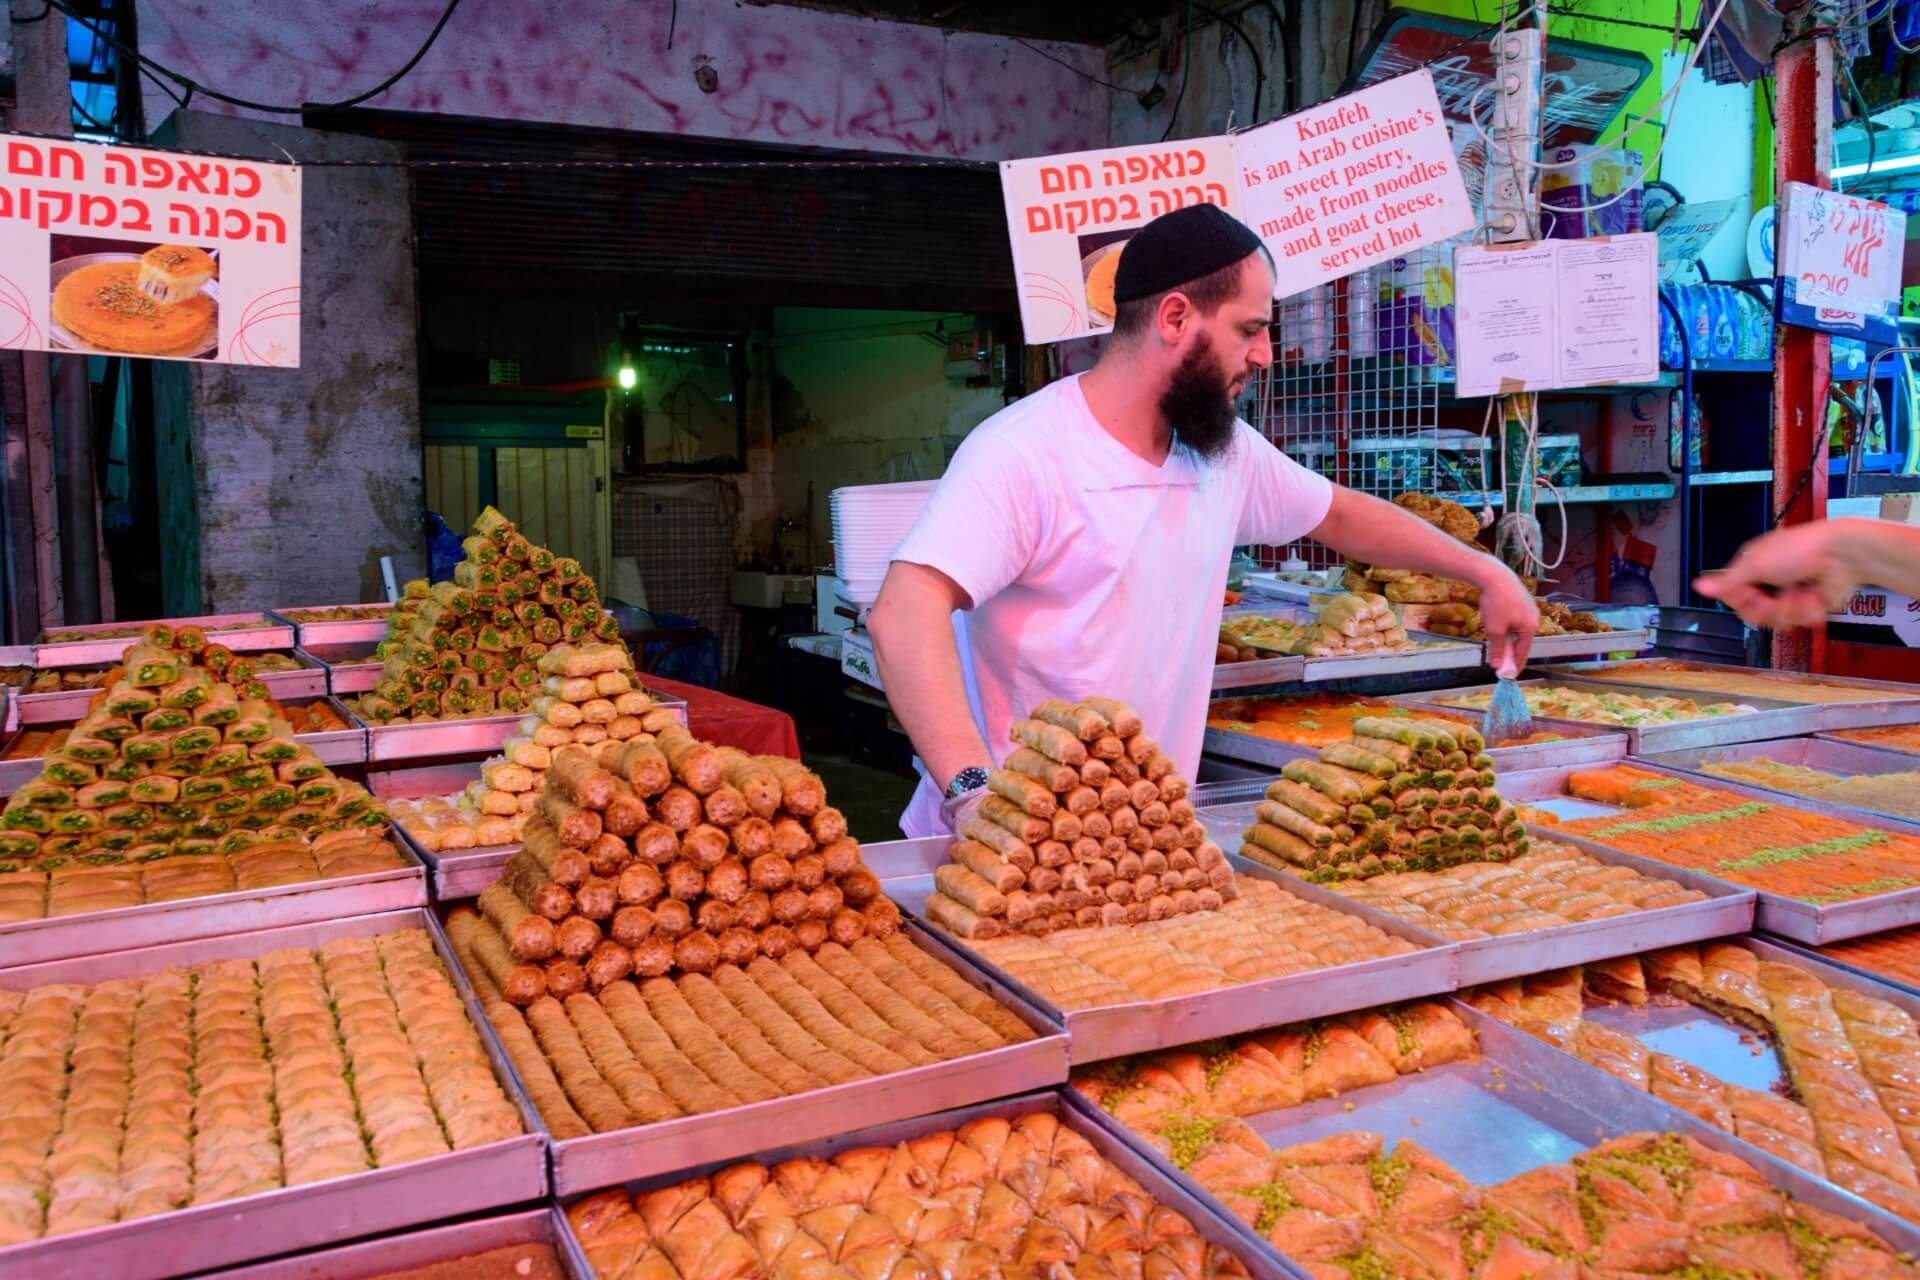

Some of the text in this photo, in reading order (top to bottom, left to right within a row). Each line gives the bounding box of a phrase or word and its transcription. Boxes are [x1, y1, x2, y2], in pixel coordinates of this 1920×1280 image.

[1296, 102, 1370, 142] Knafeh
[7, 141, 262, 199] כנאפה חם
[1244, 108, 1435, 187] is an Arab cuisine's
[1040, 149, 1206, 195] כנאפה חם
[1284, 147, 1413, 201] sweet pastry,
[1026, 193, 1141, 235] במקום
[1259, 158, 1447, 238] made from noodles
[168, 202, 287, 244] הכנה
[1284, 191, 1443, 257] and goat cheese,
[1321, 234, 1386, 271] served
[1387, 223, 1422, 249] hot
[1844, 235, 1883, 278] ללא
[1801, 271, 1849, 299] סוכר
